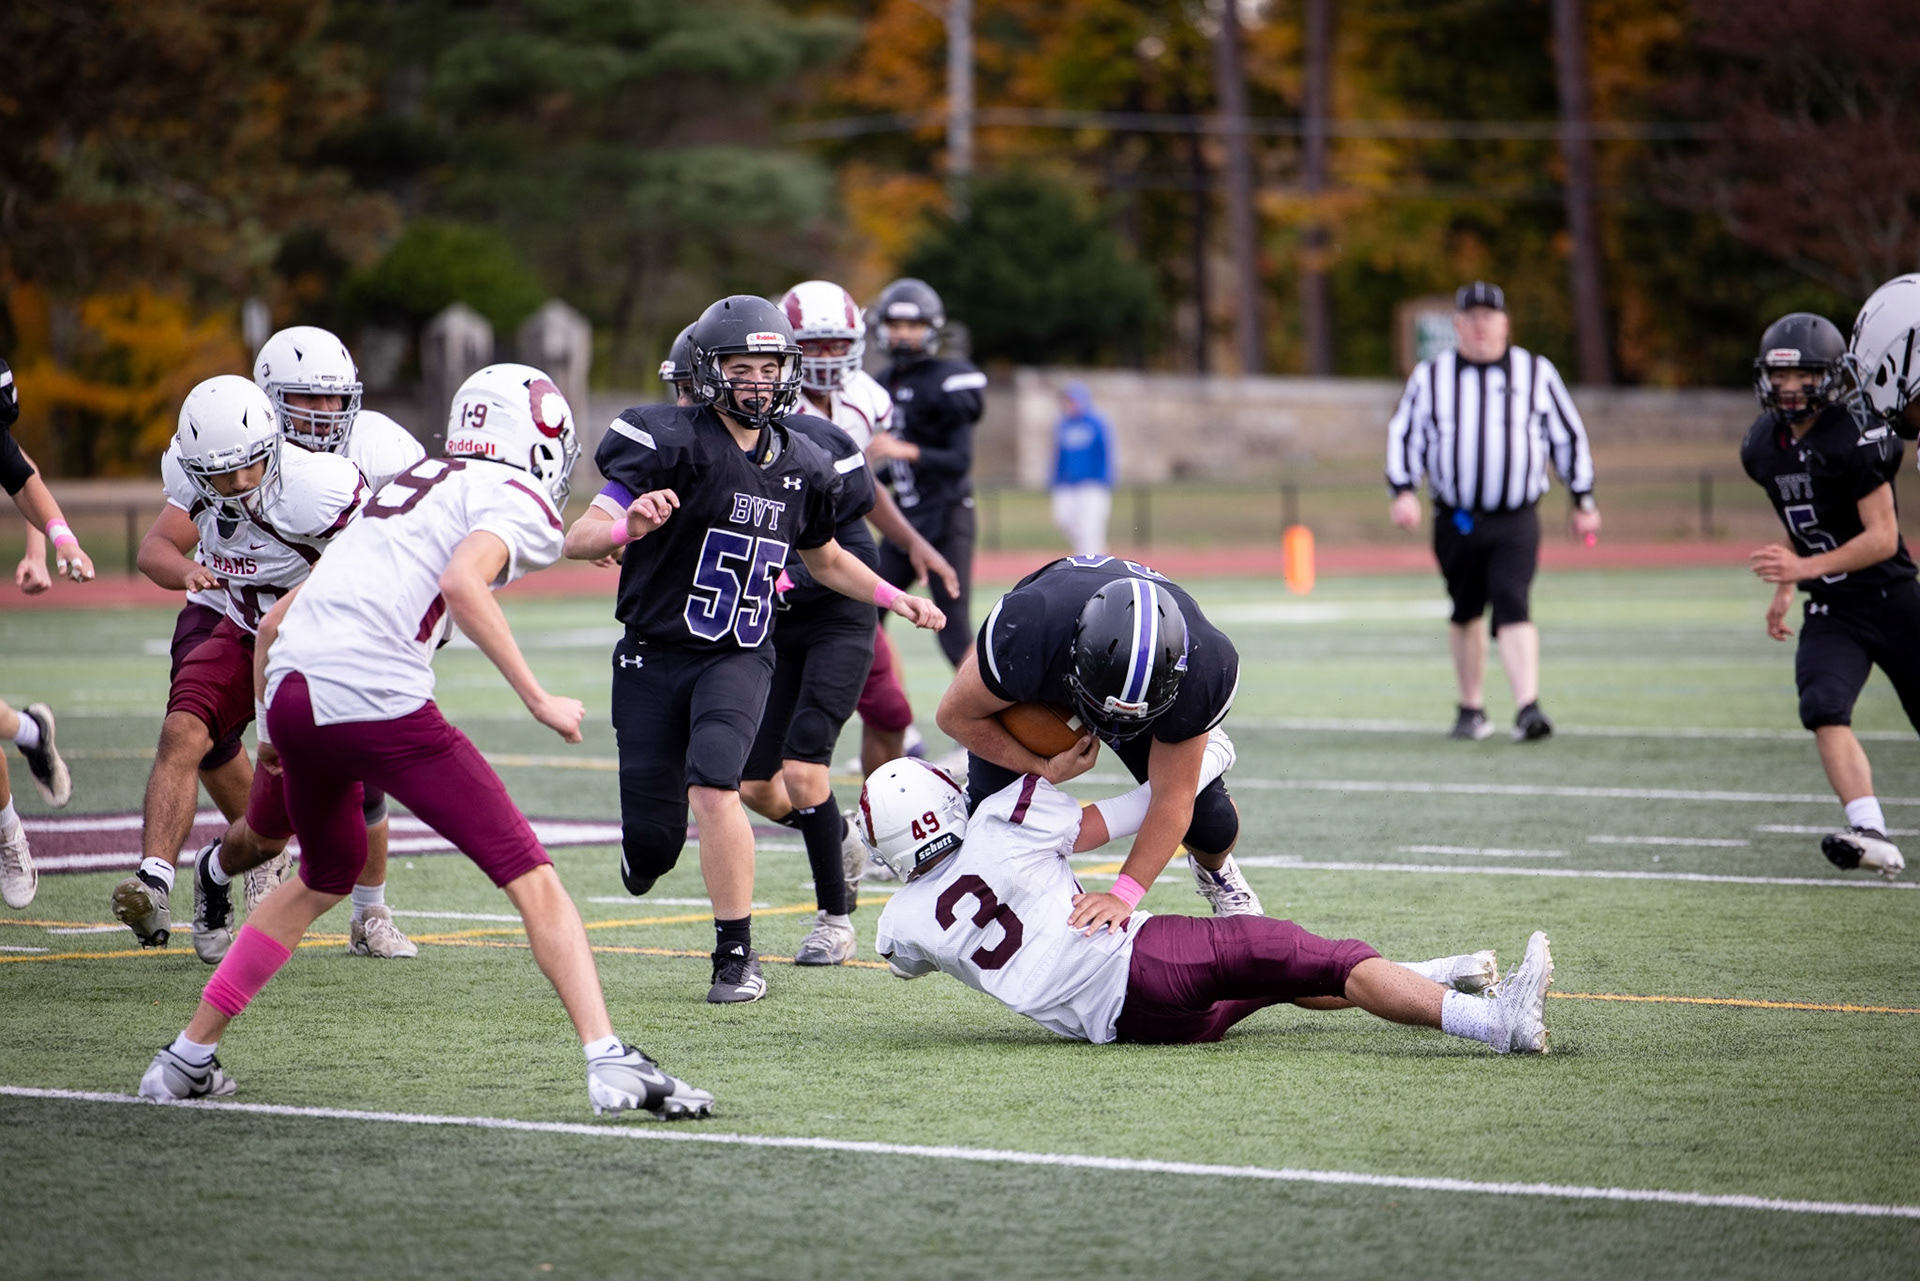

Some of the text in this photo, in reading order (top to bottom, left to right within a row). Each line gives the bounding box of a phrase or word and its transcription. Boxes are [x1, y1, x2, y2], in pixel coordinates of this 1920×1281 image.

[447, 439, 496, 456] Riddell
[728, 492, 786, 531] BVT
[210, 551, 258, 575] RAMS
[683, 528, 790, 648] 55
[911, 810, 941, 841] 49
[918, 834, 953, 861] schutt
[935, 874, 1024, 970] 3
